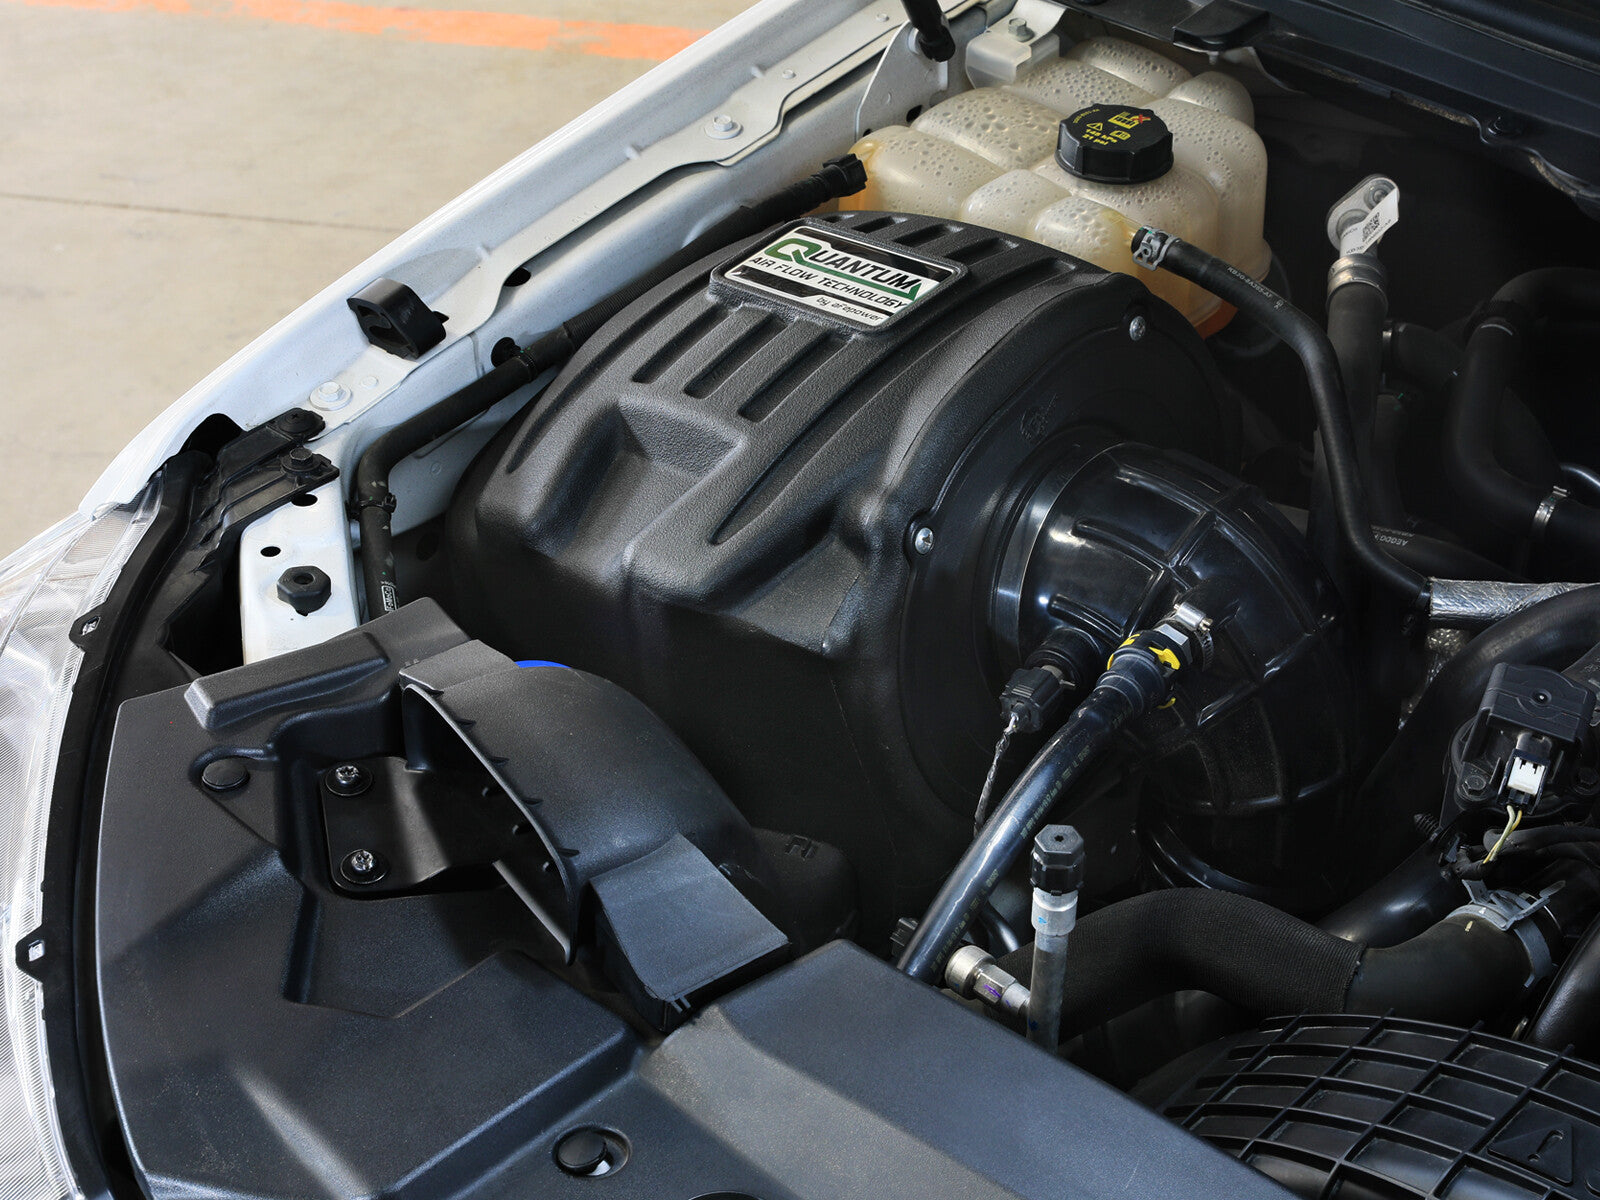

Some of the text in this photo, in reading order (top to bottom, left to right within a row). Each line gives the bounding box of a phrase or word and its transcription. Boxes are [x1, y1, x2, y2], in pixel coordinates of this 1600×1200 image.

[749, 256, 908, 309] AIR FLOW TECHNOLOGY
[764, 238, 921, 296] QUANTUM
[816, 297, 830, 306] by
